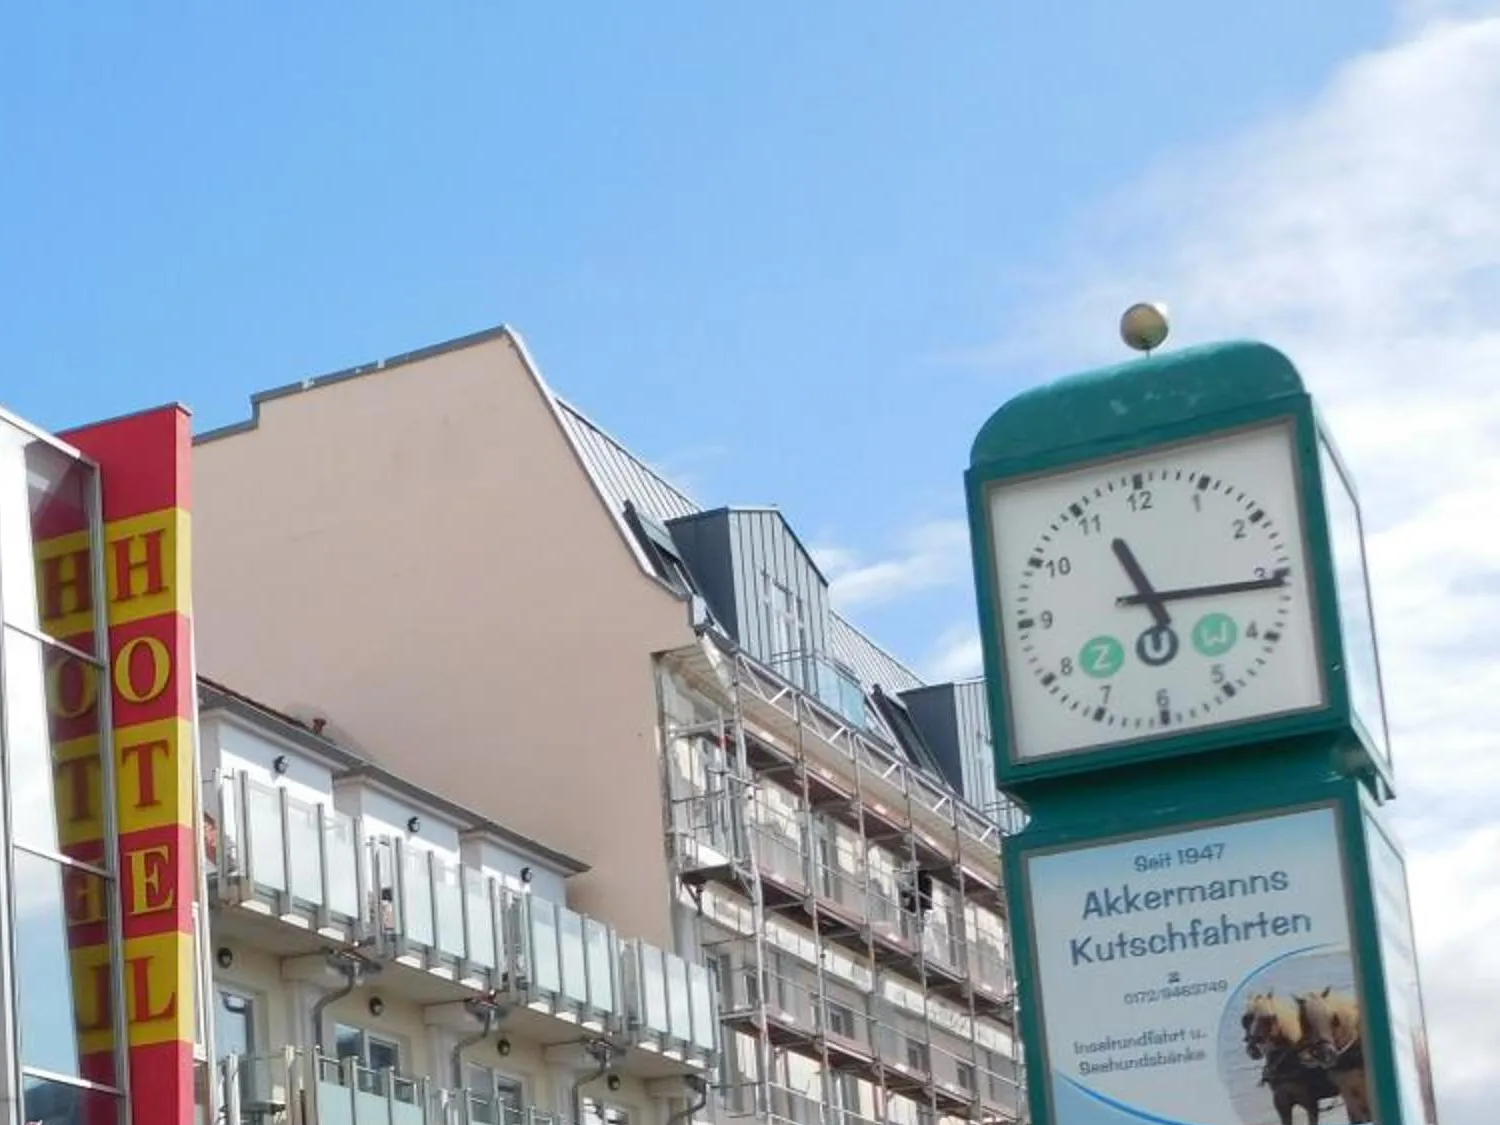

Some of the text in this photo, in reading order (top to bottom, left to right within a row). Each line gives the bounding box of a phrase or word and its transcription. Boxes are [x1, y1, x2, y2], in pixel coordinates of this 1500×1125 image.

[1126, 490, 1154, 513] 12
[1191, 493, 1202, 513] 1
[1077, 514, 1102, 536] 11
[1231, 518, 1247, 540] 2
[1044, 556, 1072, 578] 10
[1039, 610, 1054, 629] 9
[1244, 621, 1260, 640] 4
[1059, 655, 1074, 677] 8
[1091, 645, 1113, 671] Z
[1210, 663, 1226, 685] 5
[1098, 684, 1113, 705] 7
[1155, 687, 1170, 709] 6
[109, 528, 176, 1024] HOTEL
[1133, 842, 1226, 873] Seit 1947
[1081, 869, 1290, 920] Akkermanns
[1069, 910, 1313, 967] Kutschfahrten
